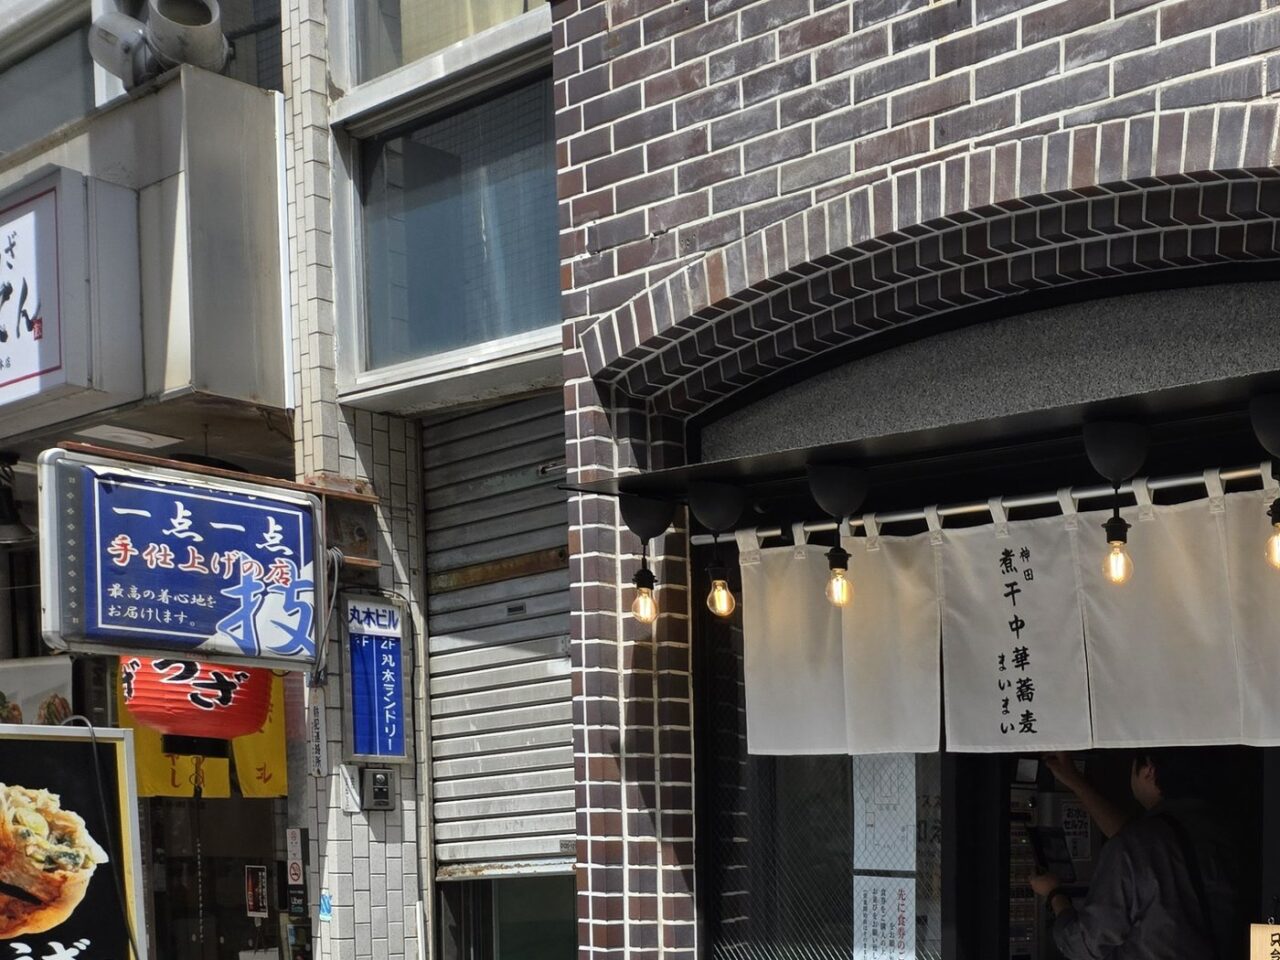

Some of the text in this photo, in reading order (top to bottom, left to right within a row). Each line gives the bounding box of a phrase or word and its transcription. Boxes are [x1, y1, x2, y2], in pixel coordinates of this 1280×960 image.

[112, 501, 294, 555] 一点一点
[107, 534, 294, 588] 手仕上げの店
[1019, 546, 1034, 581] 神田
[107, 583, 217, 608] 最高の着心地を
[108, 604, 196, 627] お届けします。
[216, 552, 315, 656] 技
[350, 605, 399, 628] 丸木ビル
[999, 548, 1038, 734] 煮干中華蕎麦
[381, 654, 396, 751] 丸木ランドリー
[998, 653, 1015, 734] まいまい
